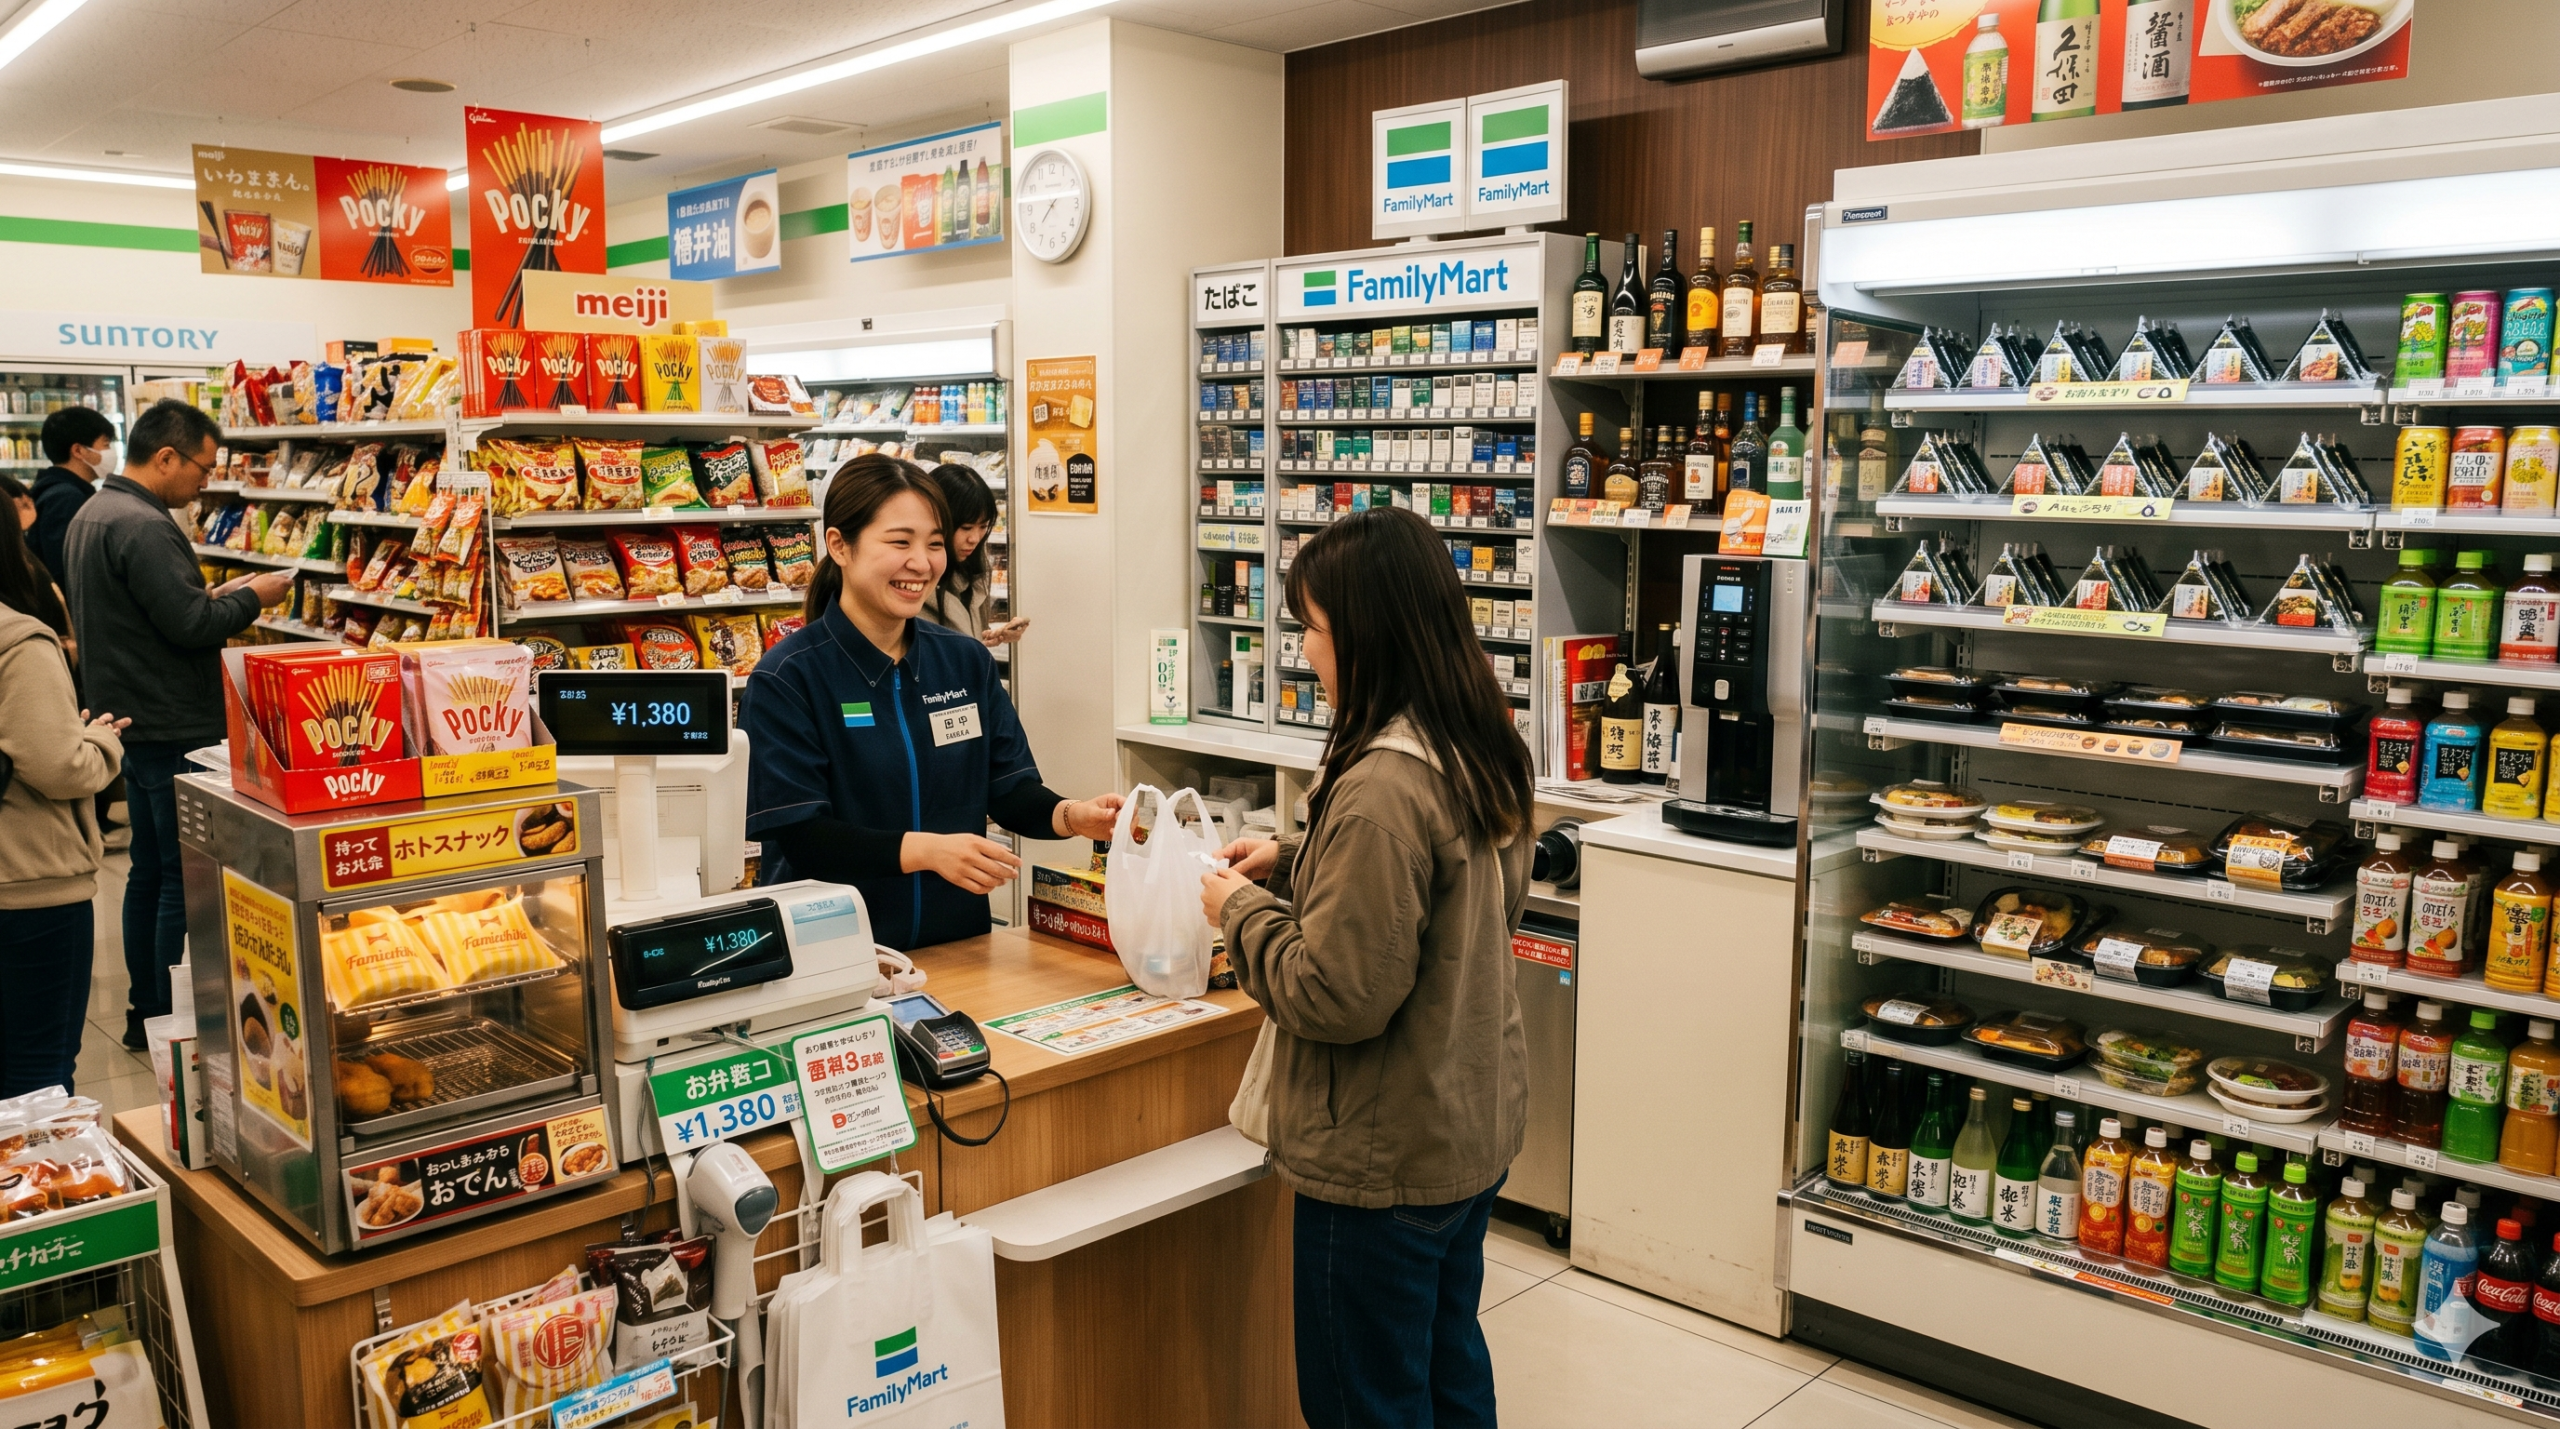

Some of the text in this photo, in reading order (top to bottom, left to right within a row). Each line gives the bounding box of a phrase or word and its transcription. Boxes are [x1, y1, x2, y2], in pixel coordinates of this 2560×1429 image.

[1048, 163, 1056, 175] 12
[1383, 192, 1454, 213] FamilyMart
[1478, 179, 1550, 202] FamilyMart
[1348, 259, 1509, 304] FamilyMart
[576, 288, 667, 326] meiji
[1204, 283, 1258, 310] たばこ
[58, 322, 219, 350] SUNTORY
[611, 702, 691, 728] ¥1,380
[335, 836, 379, 857] 持って
[394, 825, 510, 861] ホトスナック
[674, 1093, 776, 1145] ¥1,380
[846, 1364, 948, 1418] FamilyMart
